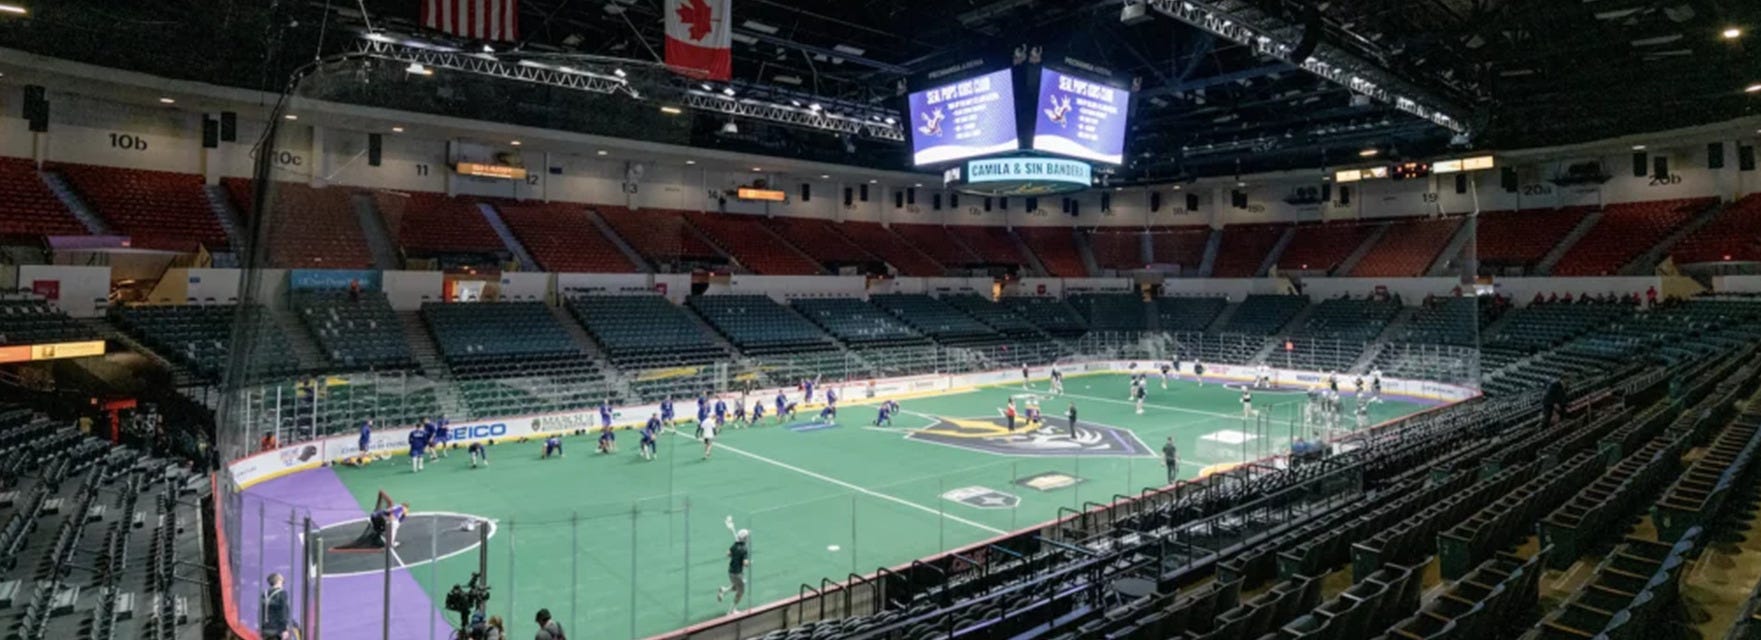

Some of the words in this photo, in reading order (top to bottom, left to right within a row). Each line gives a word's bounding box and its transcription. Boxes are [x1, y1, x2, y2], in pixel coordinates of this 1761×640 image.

[109, 132, 148, 151] 10b
[416, 164, 428, 176] 11
[971, 163, 1009, 177] CAMILA
[1013, 163, 1021, 175] &
[1025, 163, 1042, 175] SIN
[1046, 163, 1084, 177] BANDERA
[526, 174, 539, 185] 12
[1648, 173, 1682, 187] 20b
[622, 182, 638, 194] 13
[1523, 183, 1552, 196] 20a
[1422, 192, 1438, 203] 19
